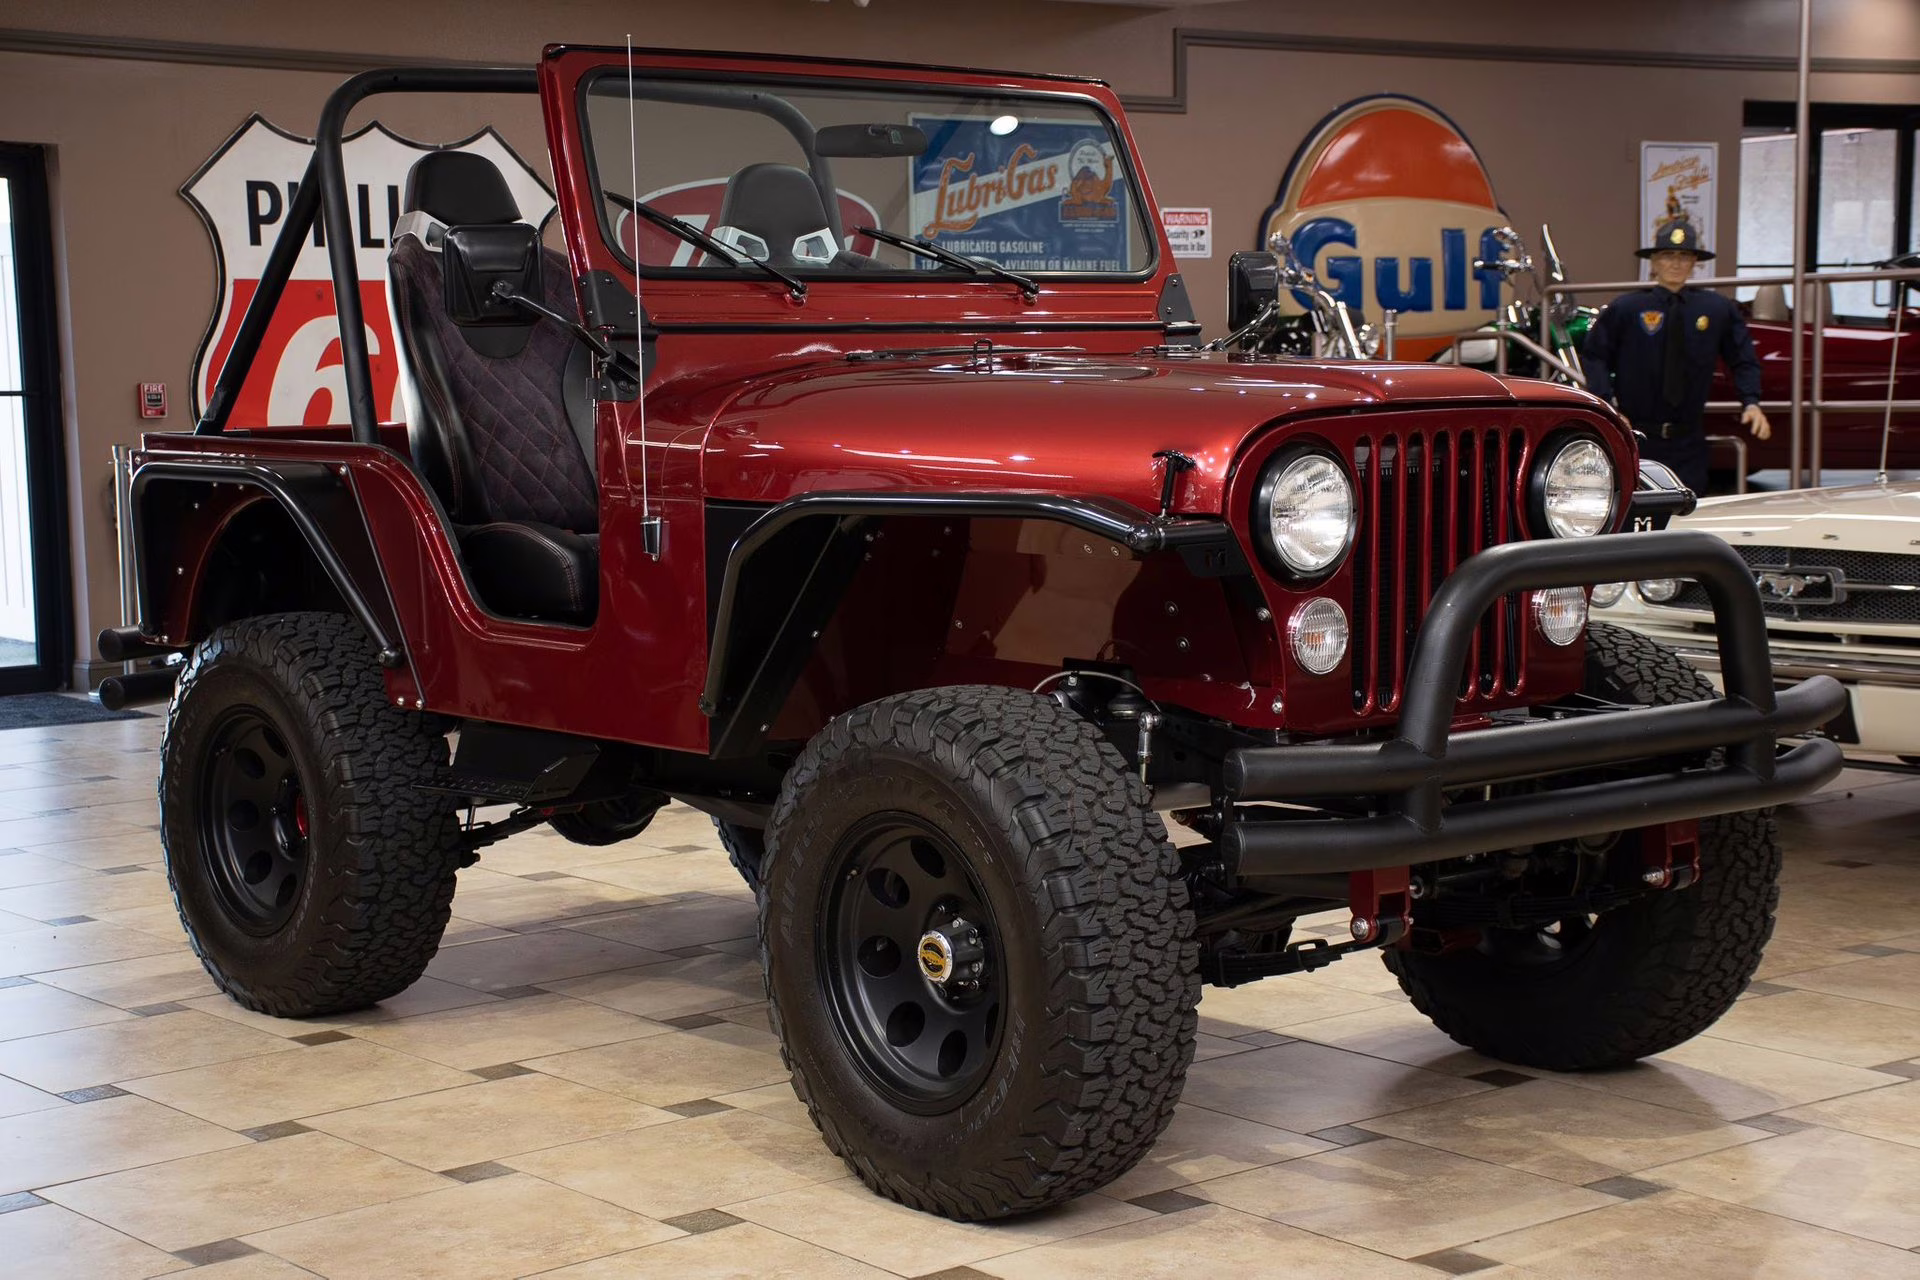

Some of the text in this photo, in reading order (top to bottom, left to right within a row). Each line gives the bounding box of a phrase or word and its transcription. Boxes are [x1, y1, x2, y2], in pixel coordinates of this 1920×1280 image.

[1165, 213, 1207, 225] WARNING
[1000, 241, 1044, 254] GASOLINE
[1048, 259, 1061, 271] OR
[1063, 259, 1097, 271] MARINE
[1100, 259, 1121, 271] FUEL
[1286, 216, 1510, 315] Gulf
[144, 384, 163, 393] FIRE
